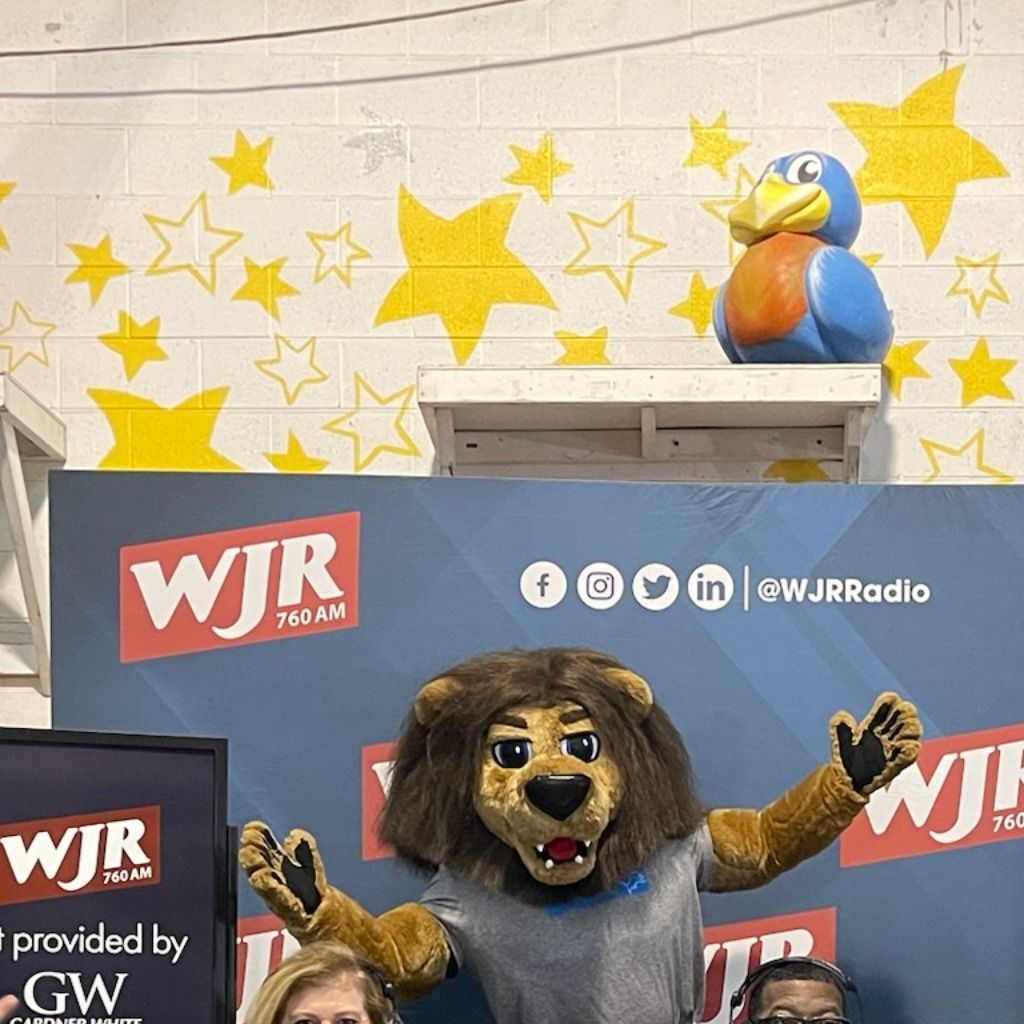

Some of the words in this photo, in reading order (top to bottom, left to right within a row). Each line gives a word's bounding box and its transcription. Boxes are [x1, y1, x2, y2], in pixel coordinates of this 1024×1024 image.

[129, 533, 345, 640] WJR
[757, 577, 931, 604] @WJRRadio
[276, 610, 312, 630] 760
[314, 602, 346, 624] AM
[0, 818, 151, 892] WJR
[103, 869, 129, 885] 760
[130, 866, 152, 882] AM
[12, 921, 143, 962] provided
[152, 922, 189, 964] by
[23, 971, 129, 1016] GW
